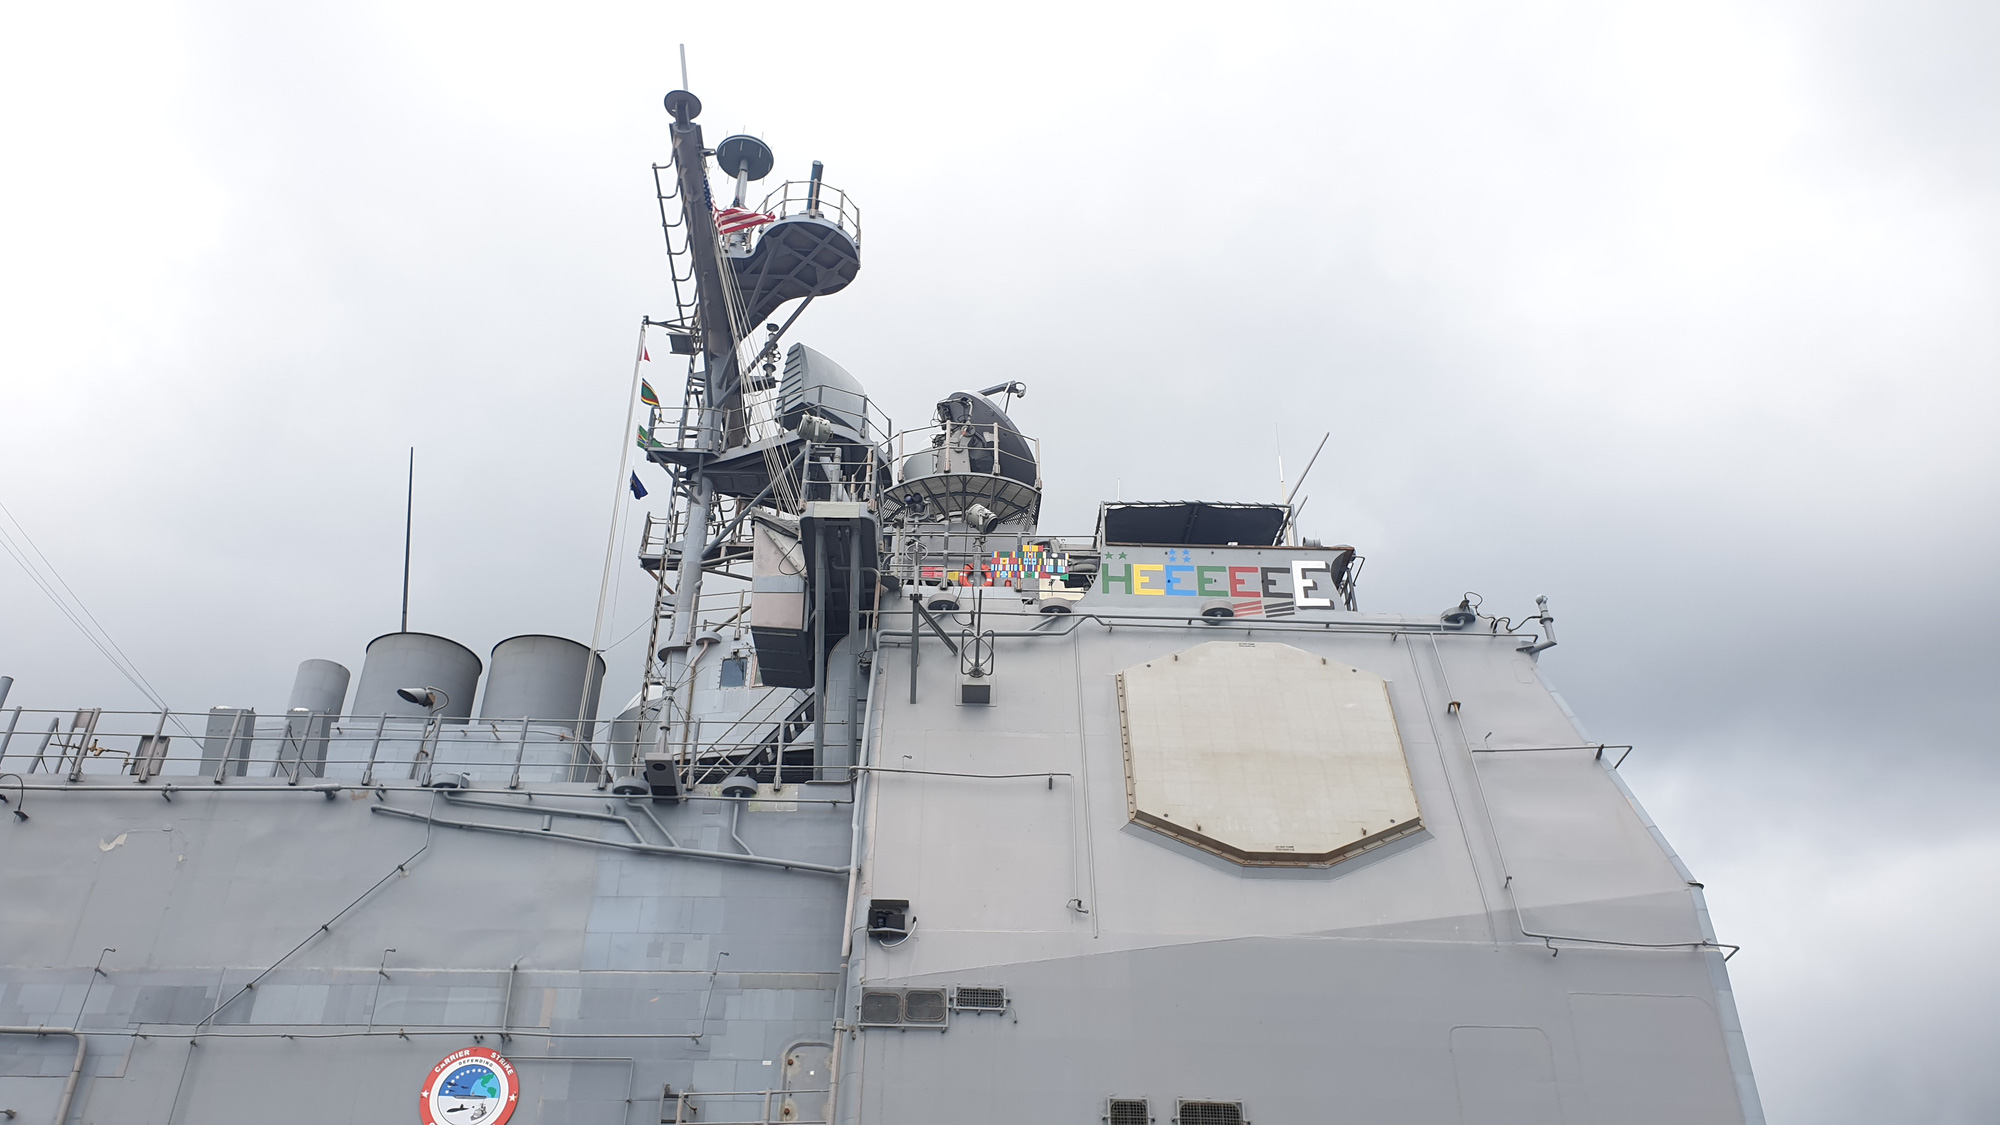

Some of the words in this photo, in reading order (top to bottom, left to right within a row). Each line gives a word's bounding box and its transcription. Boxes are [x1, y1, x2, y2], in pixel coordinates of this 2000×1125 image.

[435, 1050, 470, 1073] CARRIER
[490, 1052, 514, 1075] STRIKE
[458, 1059, 493, 1067] DEFENDING
